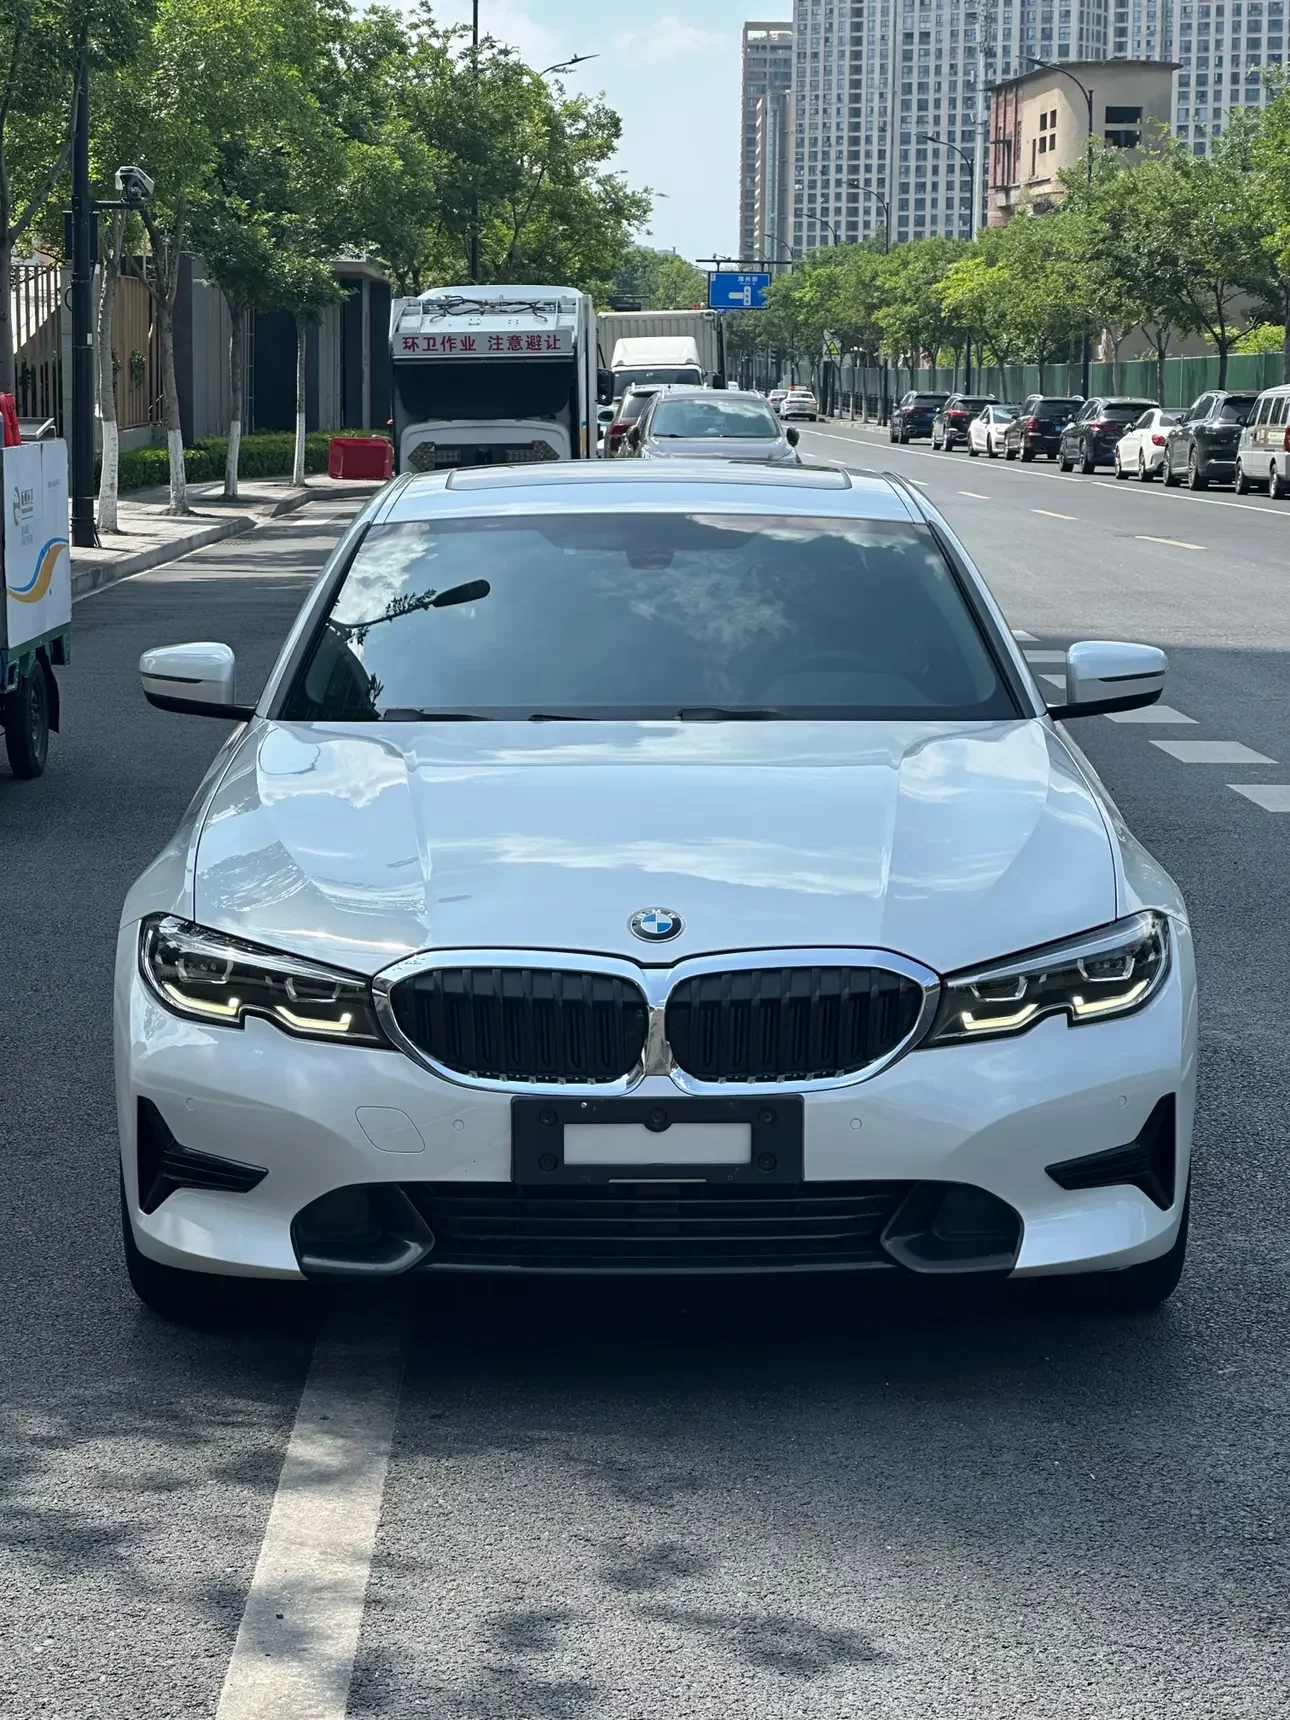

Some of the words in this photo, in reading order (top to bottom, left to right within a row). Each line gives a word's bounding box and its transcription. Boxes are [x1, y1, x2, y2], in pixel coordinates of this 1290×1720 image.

[402, 336, 476, 352] 环卫作业
[488, 334, 561, 351] 注意避让
